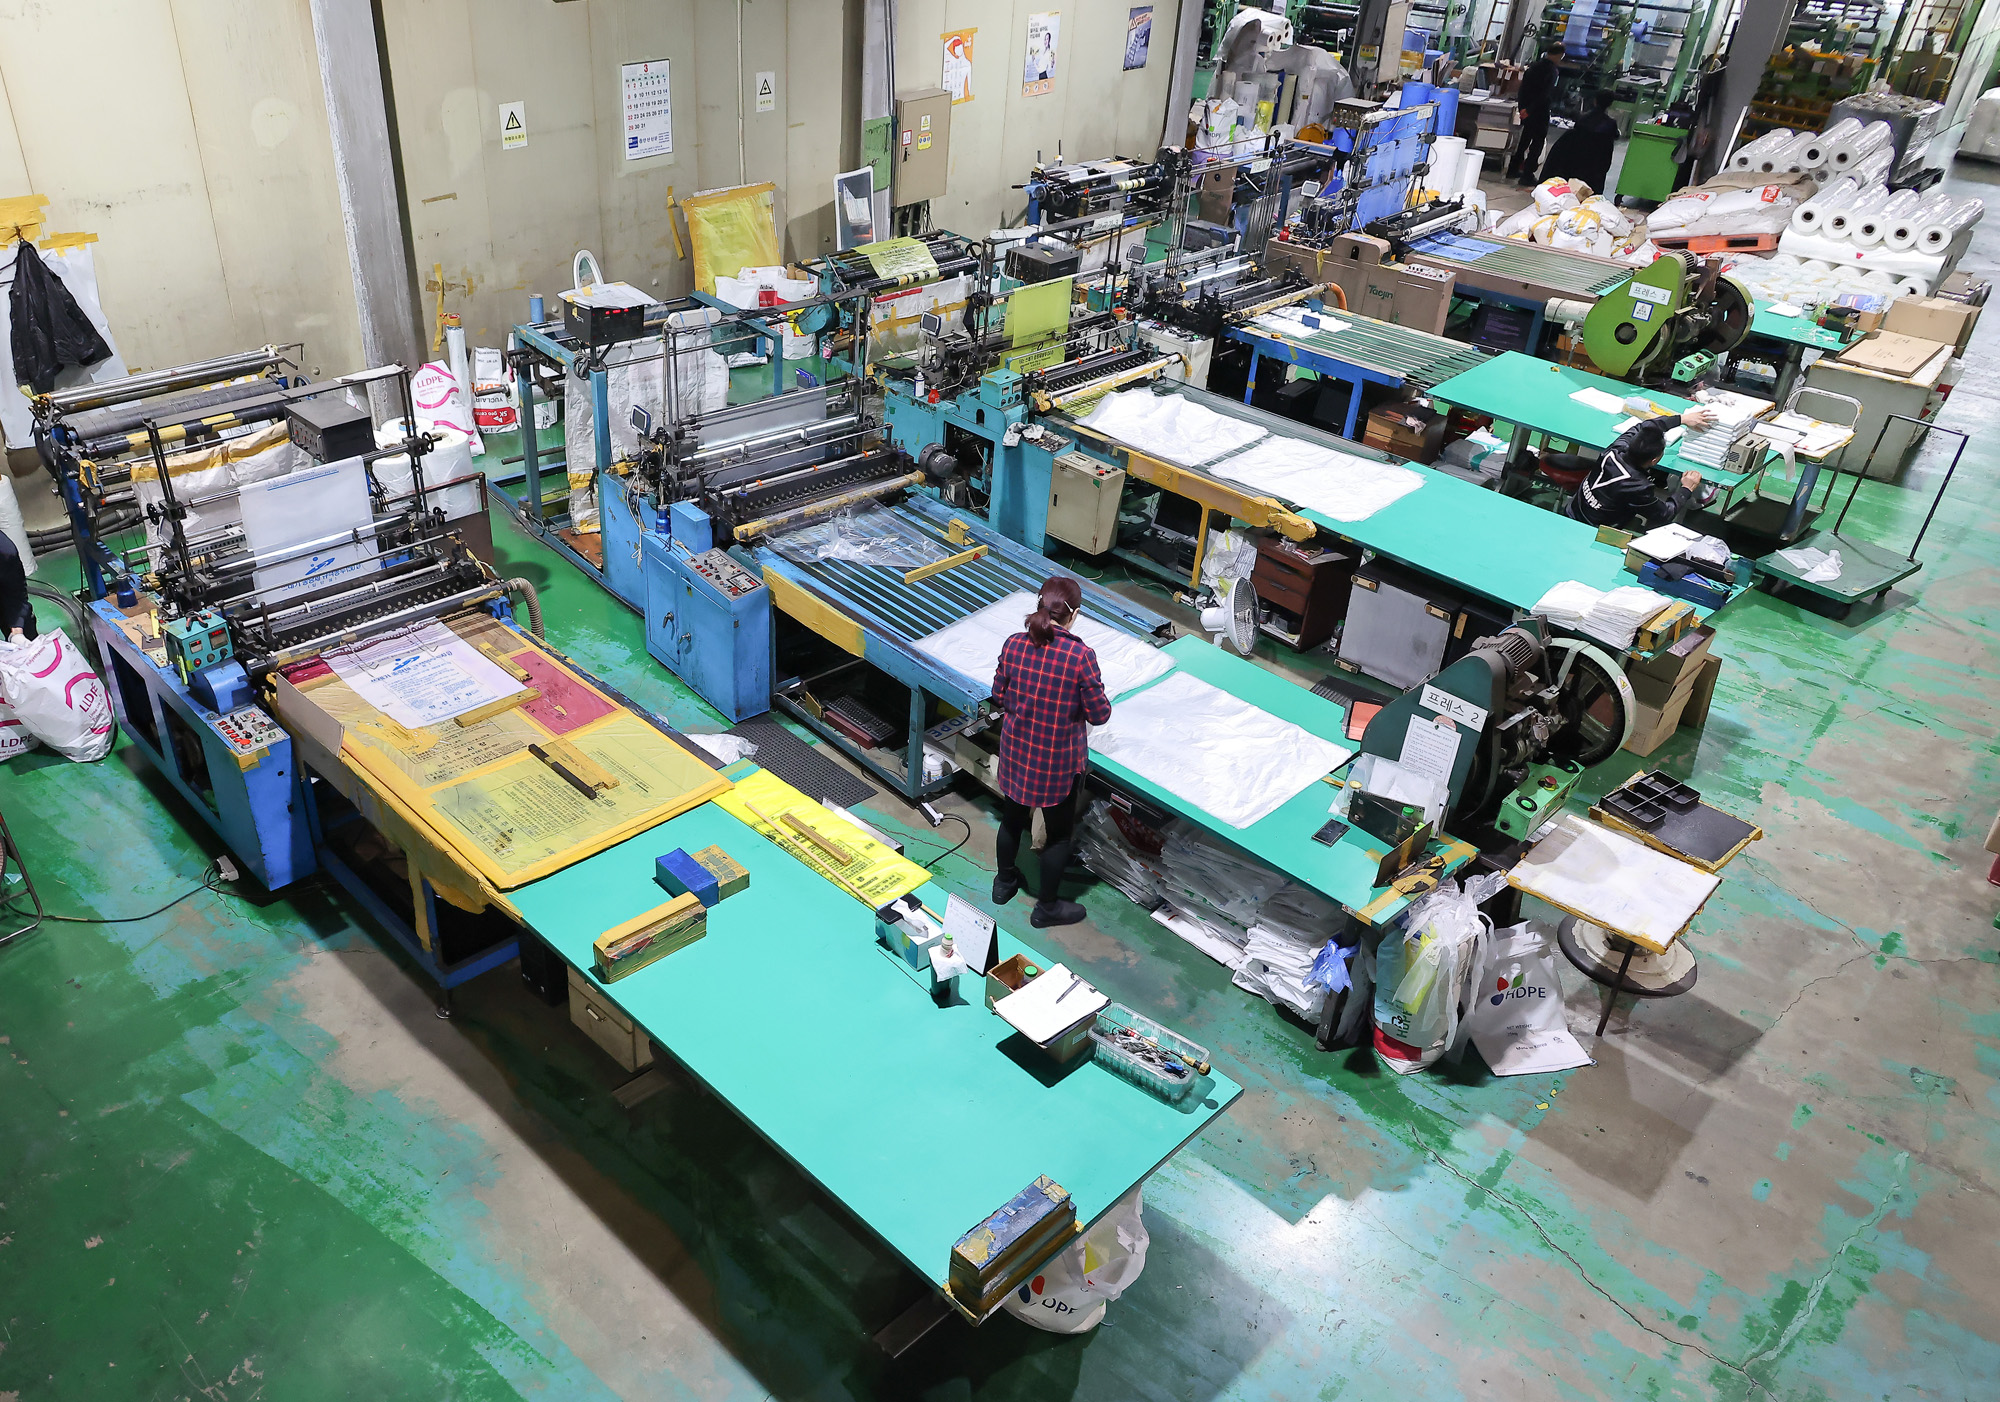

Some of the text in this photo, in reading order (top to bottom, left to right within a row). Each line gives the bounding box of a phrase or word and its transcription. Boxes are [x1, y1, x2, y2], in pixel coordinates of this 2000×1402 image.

[644, 64, 648, 72] 3
[1633, 286, 1657, 298] 프레스
[416, 376, 444, 388] LLDPE
[1427, 692, 1479, 724] 프레스 2
[1, 733, 33, 748] LDPE
[1506, 986, 1546, 1000] HDPE
